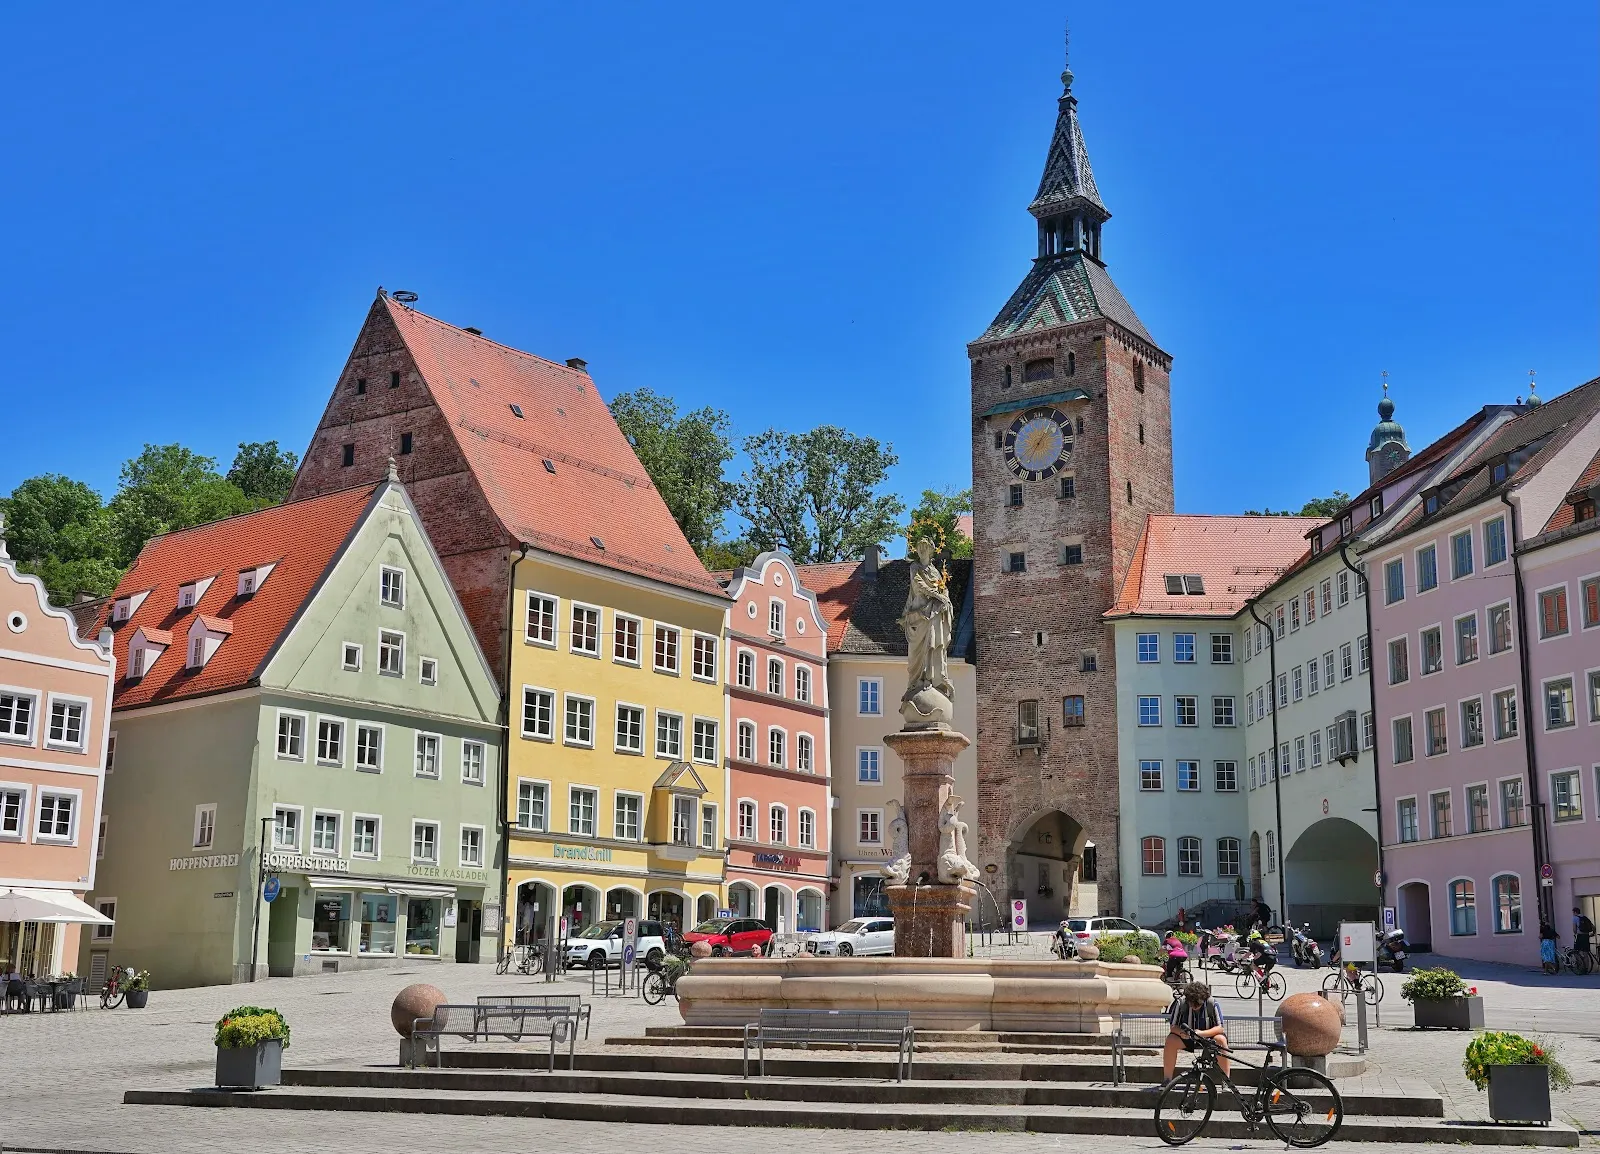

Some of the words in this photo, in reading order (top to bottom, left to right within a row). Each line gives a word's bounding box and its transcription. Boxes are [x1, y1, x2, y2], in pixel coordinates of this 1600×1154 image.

[857, 849, 878, 857] Uhren
[169, 853, 239, 871] HOFPFISTEREI
[262, 852, 350, 872] HOFPFISTEREI
[406, 864, 440, 877] TÖLZER
[443, 868, 488, 881] KASLADEN
[1386, 911, 1392, 922] P
